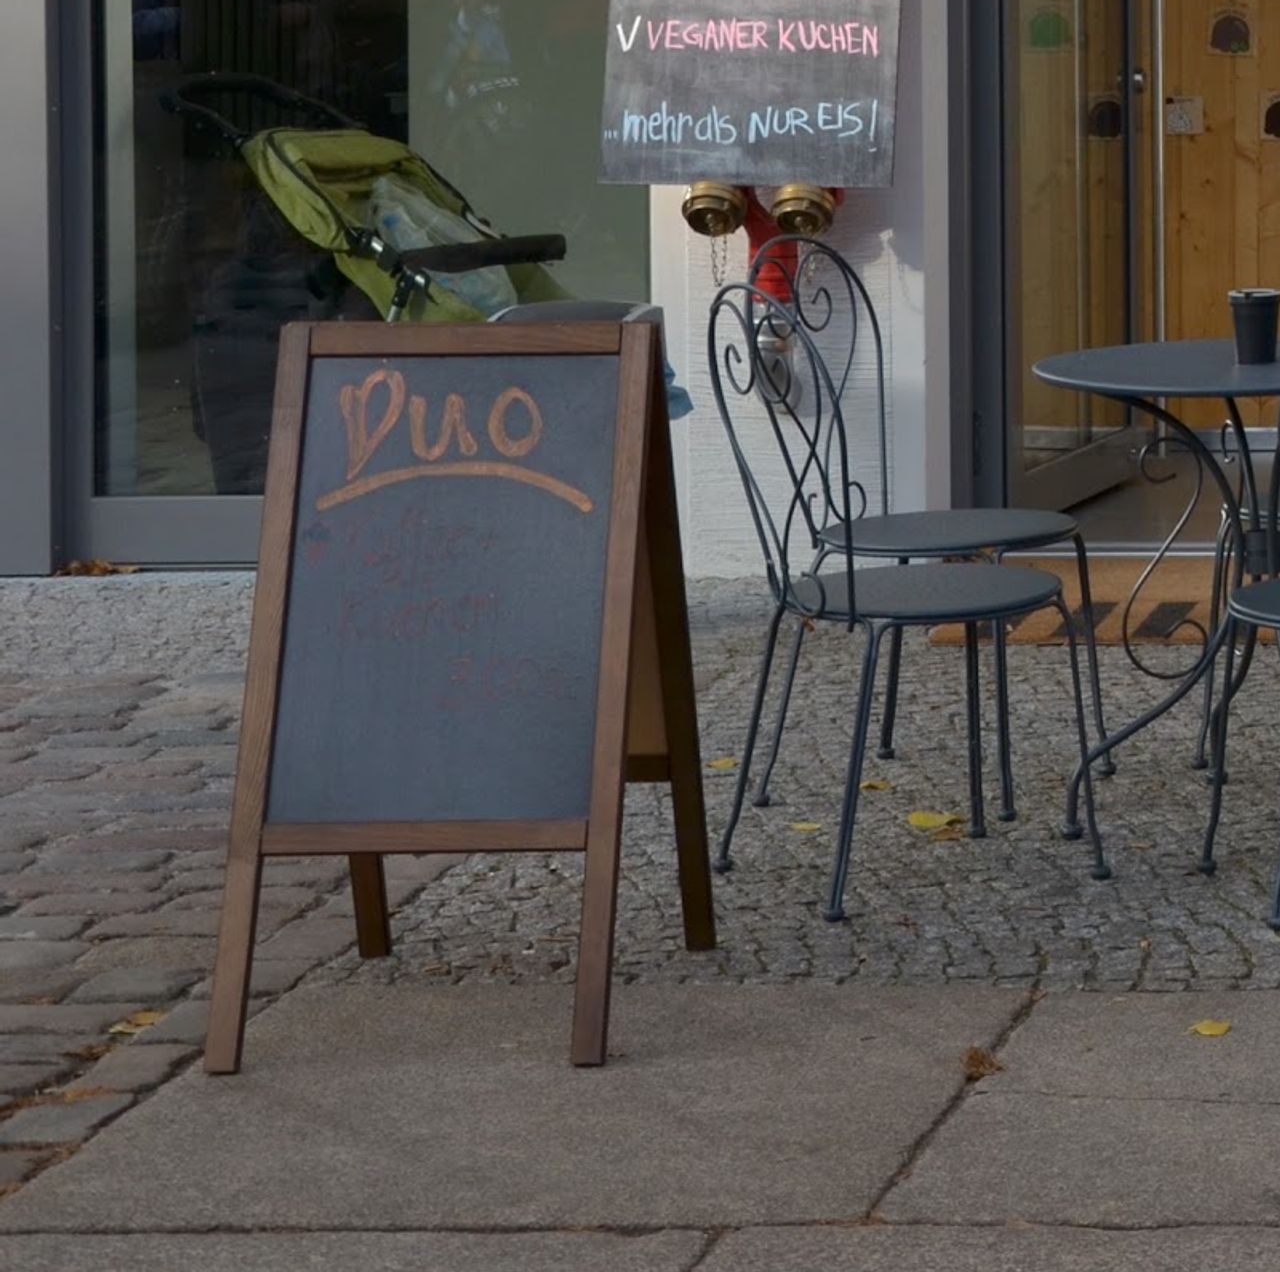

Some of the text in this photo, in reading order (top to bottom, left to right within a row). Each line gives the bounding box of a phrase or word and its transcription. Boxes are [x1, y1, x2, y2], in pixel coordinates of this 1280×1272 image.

[648, 18, 879, 58] VEGANER KUCHEN
[695, 106, 737, 144] als
[749, 105, 815, 144] NUR
